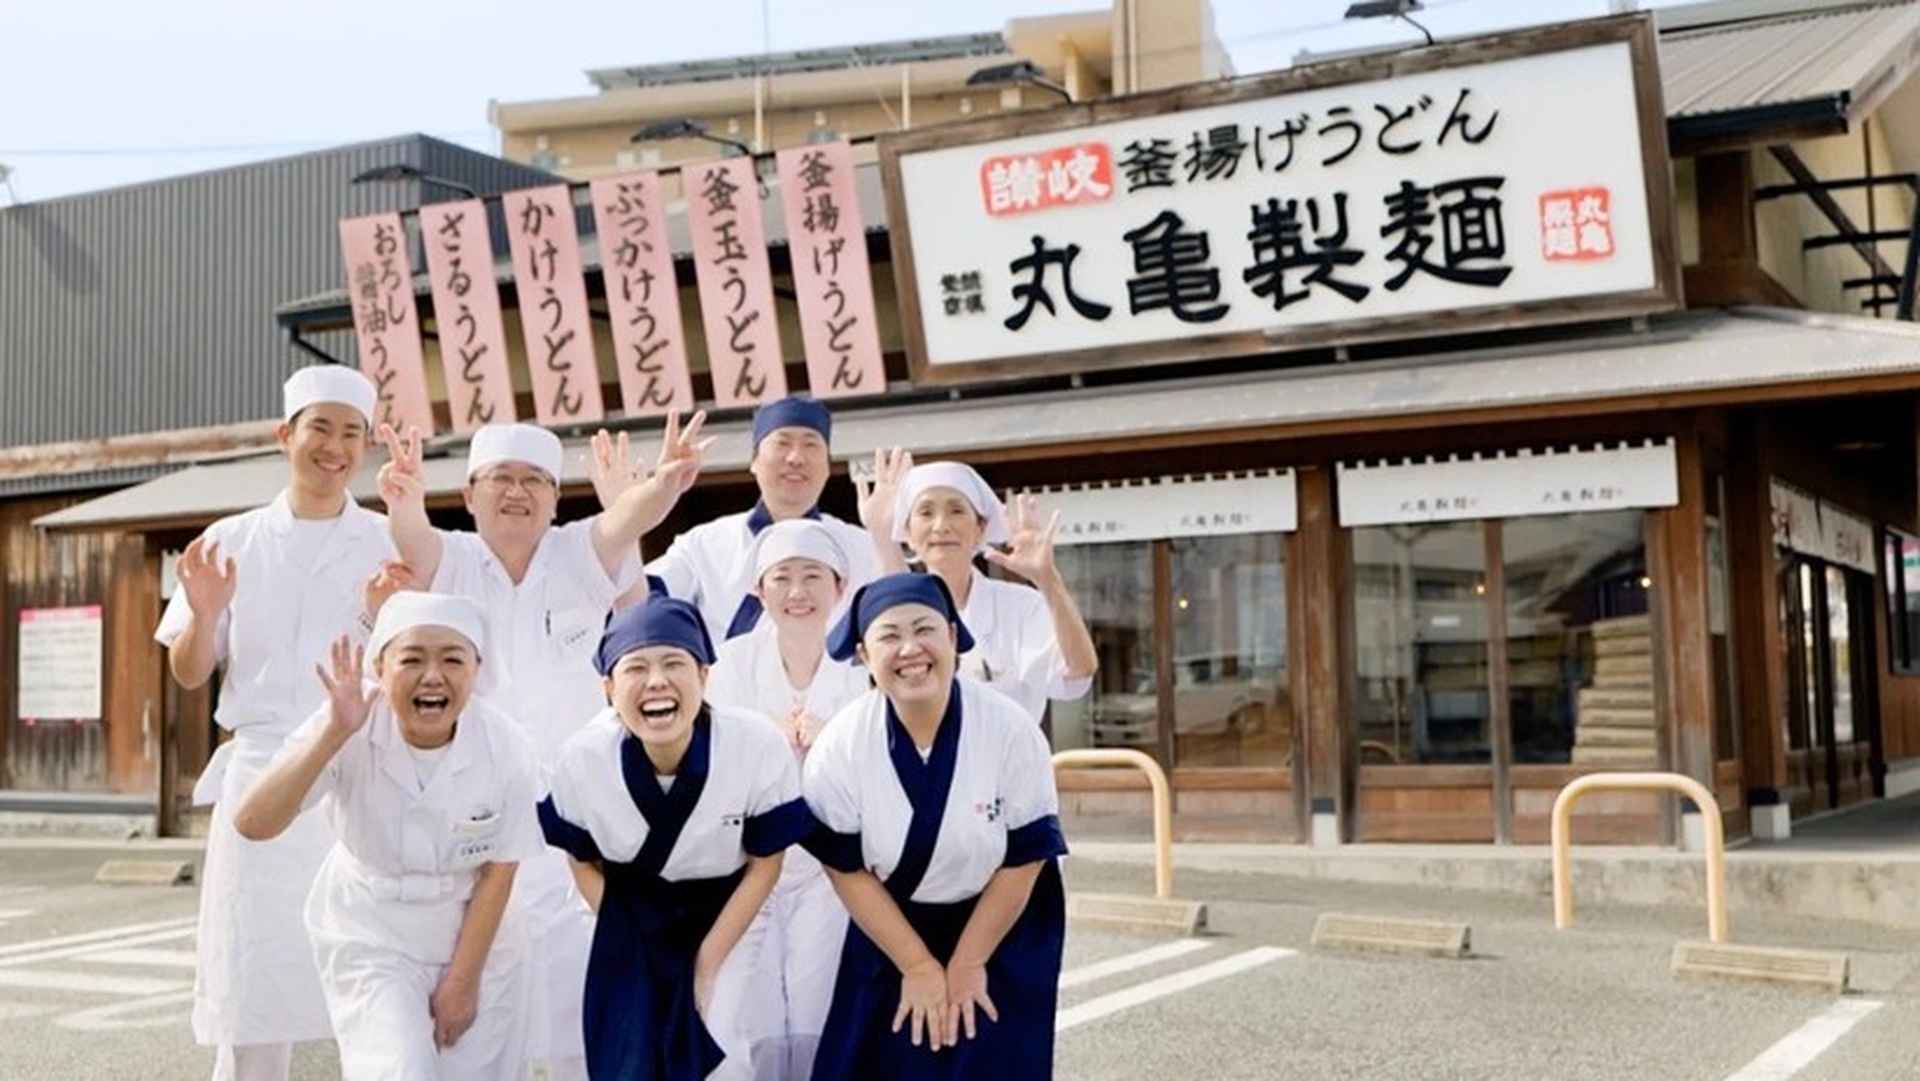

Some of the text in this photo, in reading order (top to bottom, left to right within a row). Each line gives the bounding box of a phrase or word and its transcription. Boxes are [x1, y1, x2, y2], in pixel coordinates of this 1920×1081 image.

[1118, 88, 1499, 194] 釜揚げうどん
[521, 198, 582, 415] かけうどん
[606, 182, 674, 407] ぶっかけうどん
[702, 167, 766, 397] 釜玉うどん
[799, 151, 863, 389] 釜揚げうどん
[1003, 176, 1513, 331] 丸亀製麺
